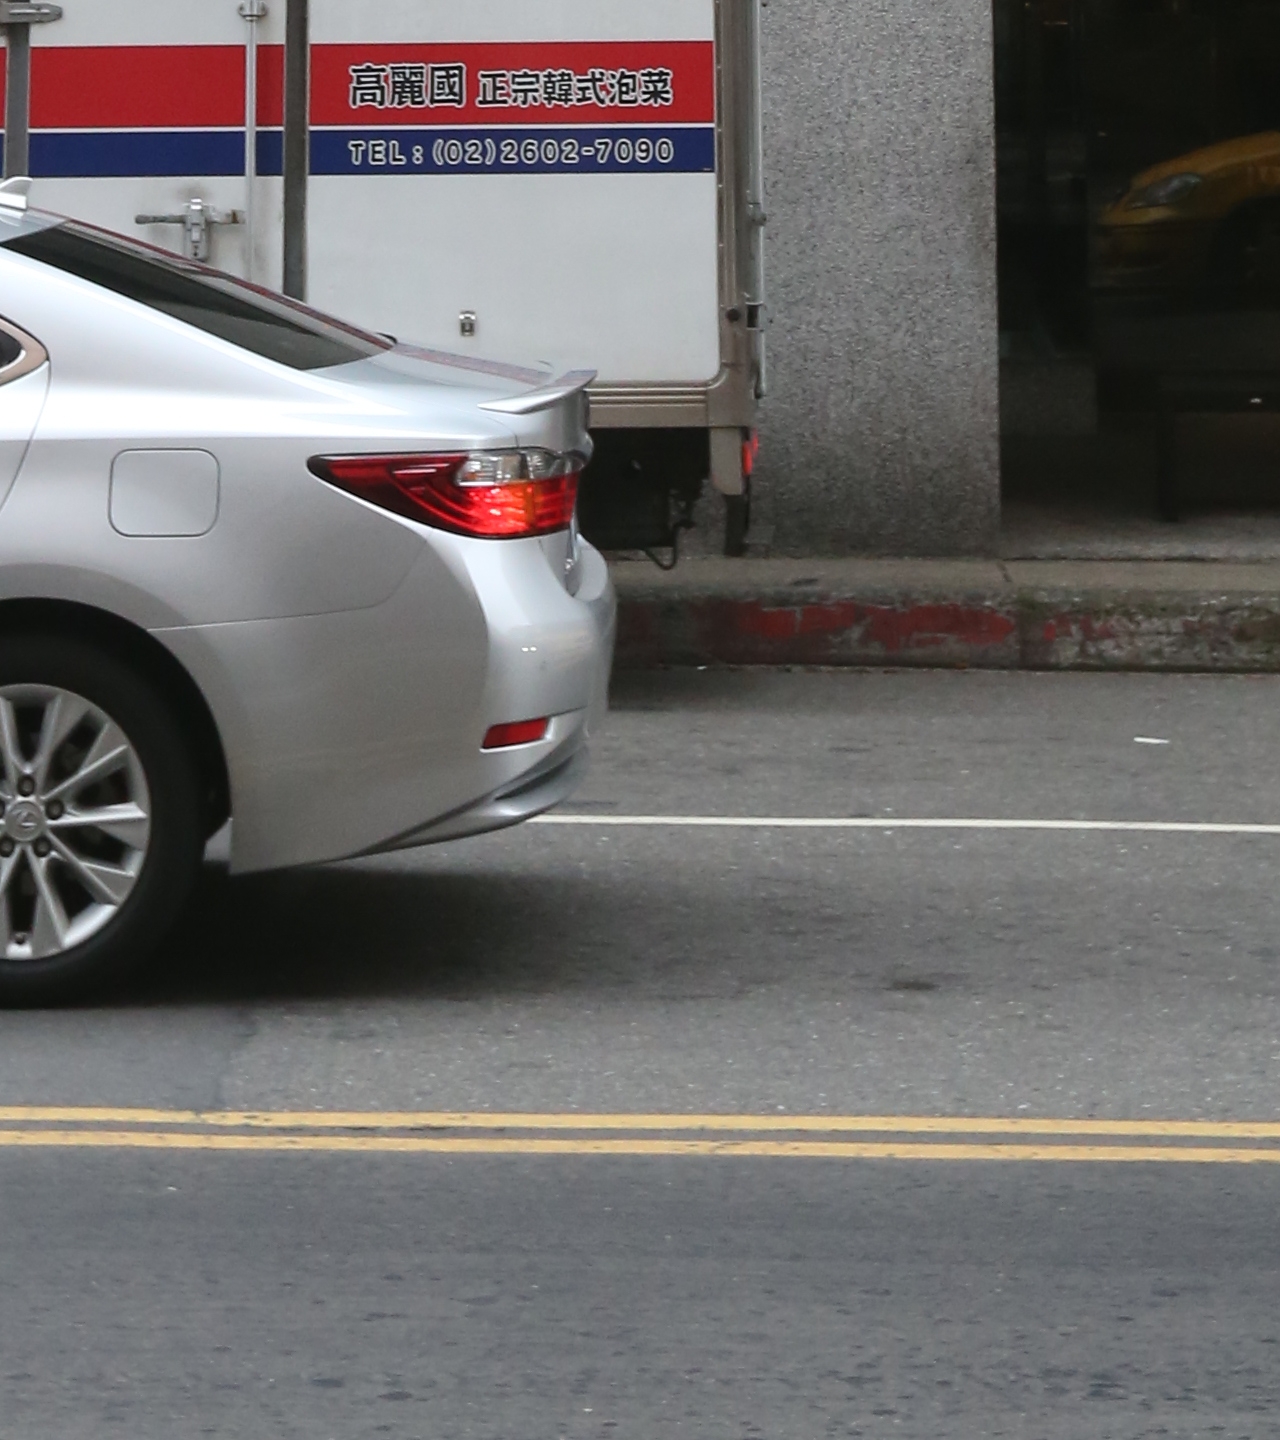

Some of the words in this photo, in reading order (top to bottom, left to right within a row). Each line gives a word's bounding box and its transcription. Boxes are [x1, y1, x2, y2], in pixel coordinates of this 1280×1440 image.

[349, 63, 466, 108] 高麗國
[476, 68, 675, 109] 正宗韓式泡菜
